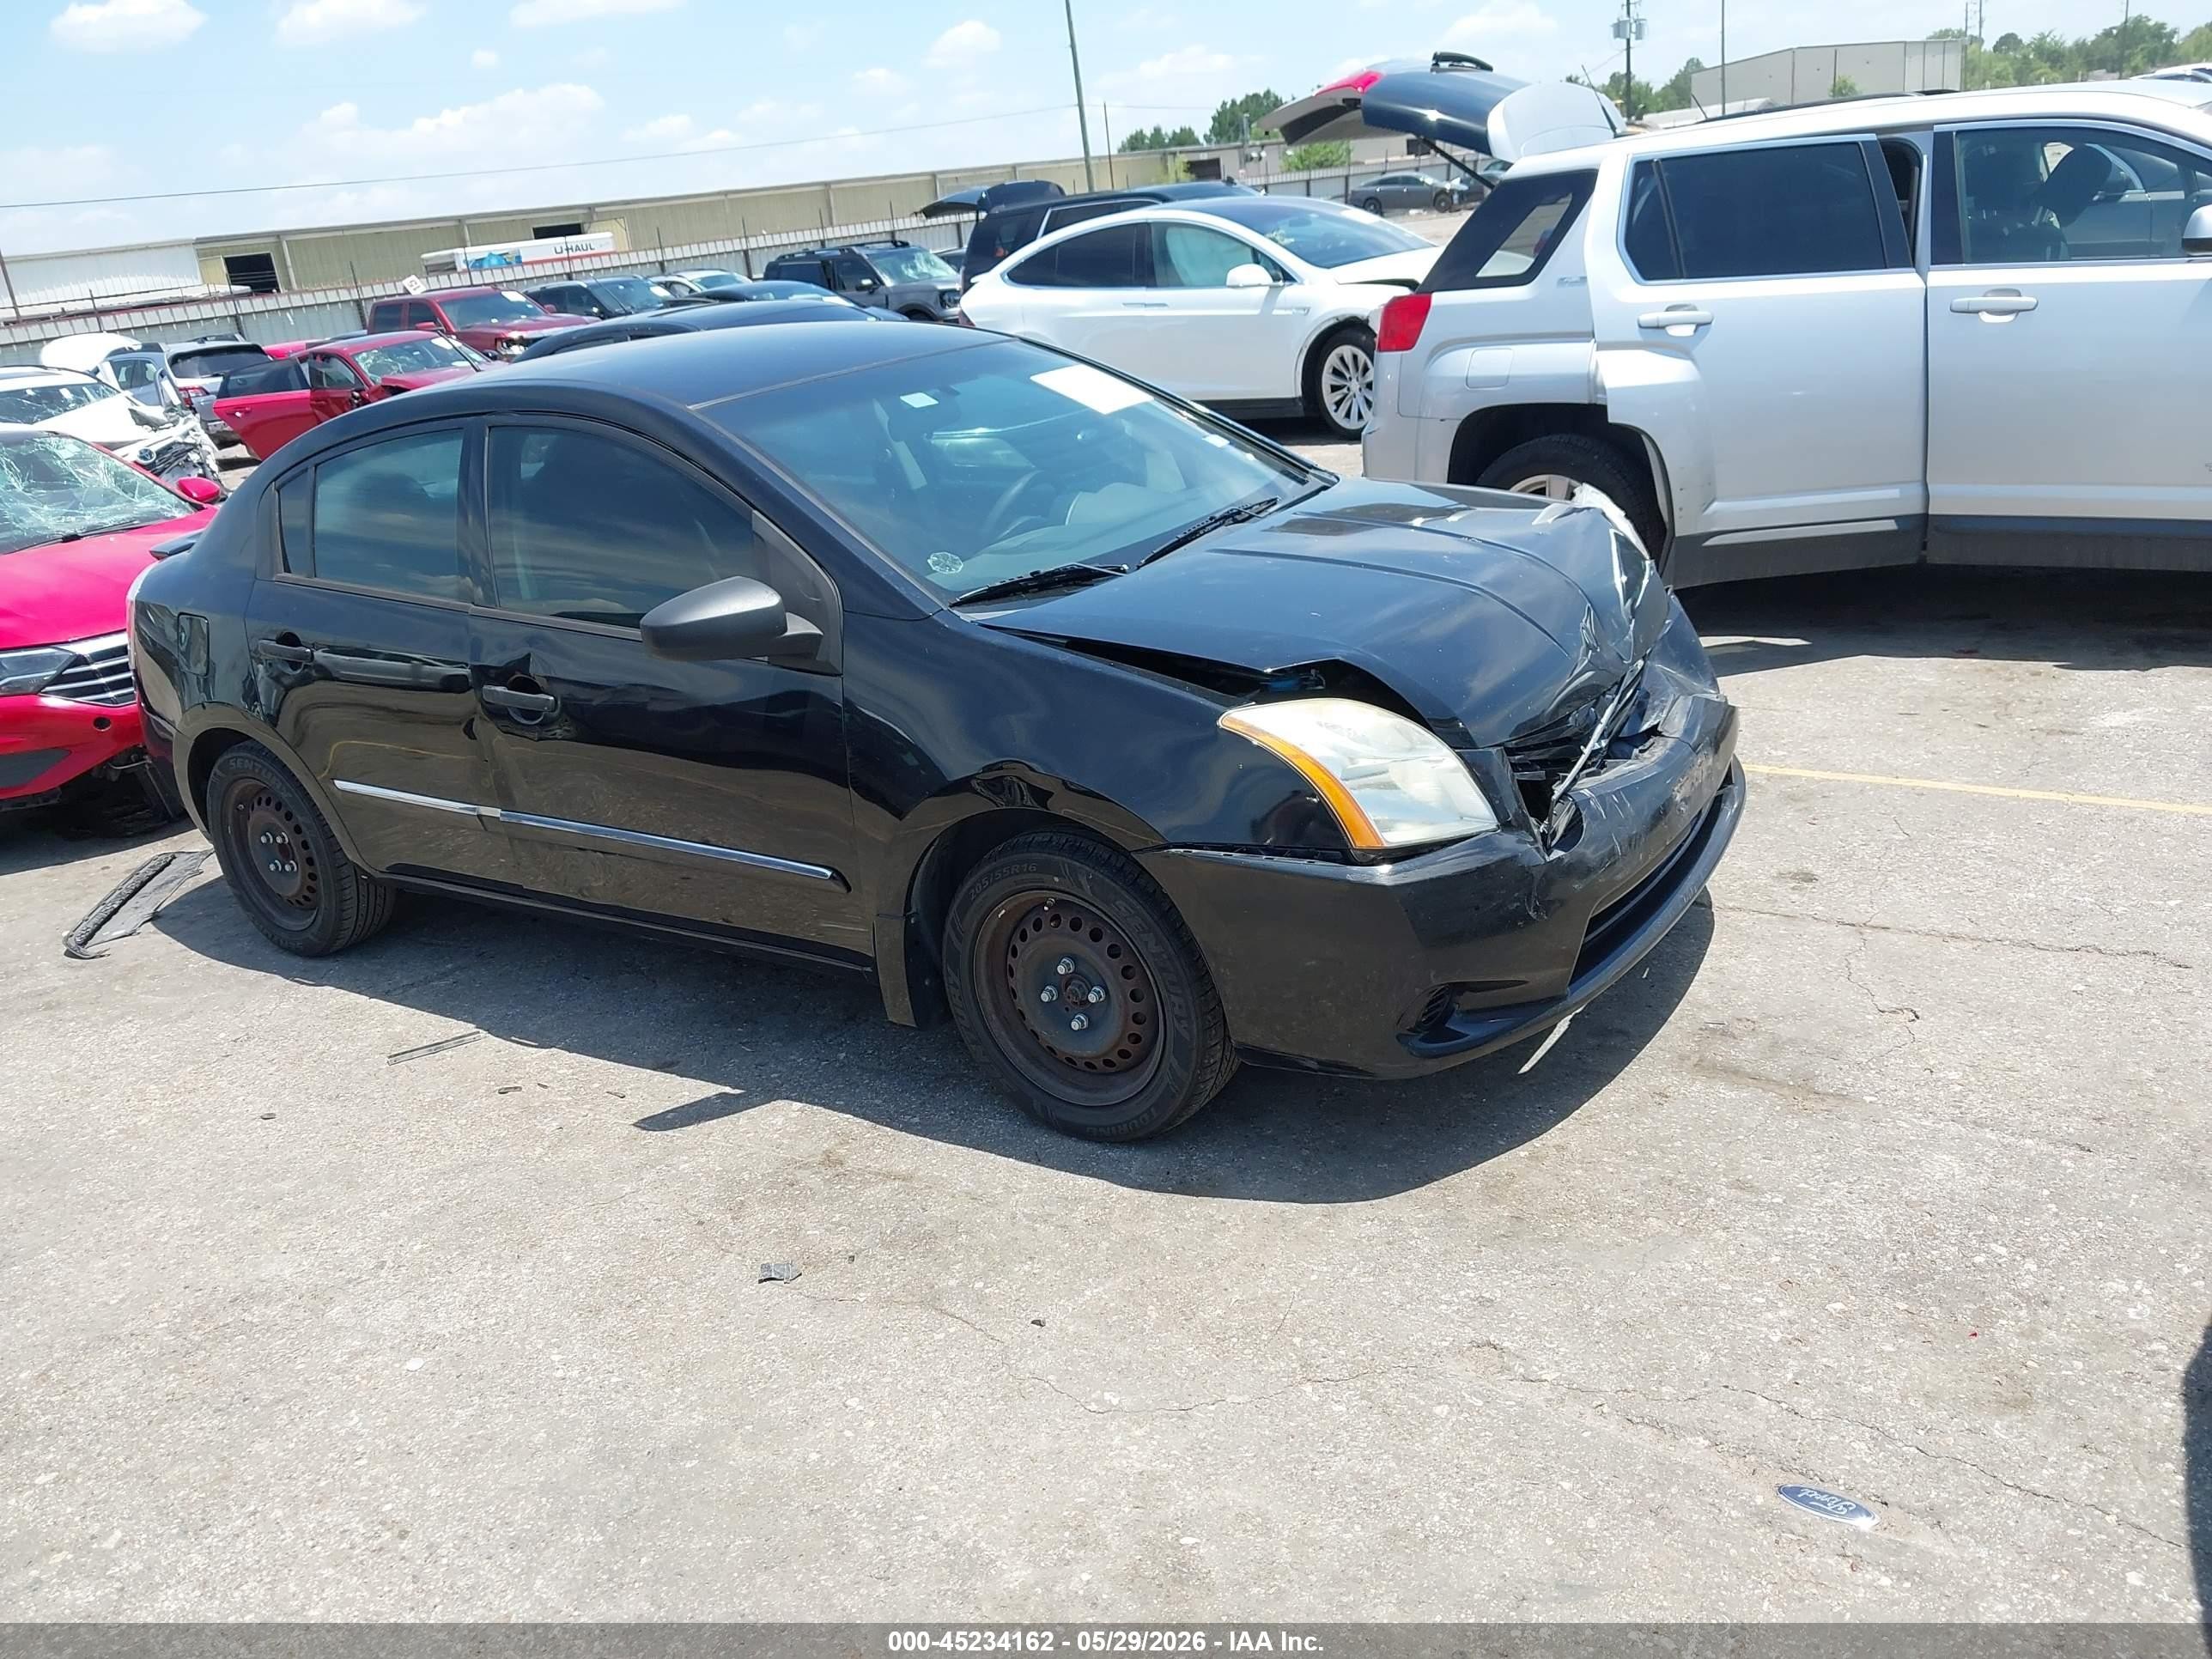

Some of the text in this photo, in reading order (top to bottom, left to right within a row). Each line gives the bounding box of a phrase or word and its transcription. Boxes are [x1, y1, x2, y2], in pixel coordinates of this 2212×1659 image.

[968, 862, 1038, 901] 205/55R16
[1112, 900, 1191, 1042] SENTURY
[1085, 1106, 1158, 1138] TOURING
[1798, 1489, 1856, 1515] Ford
